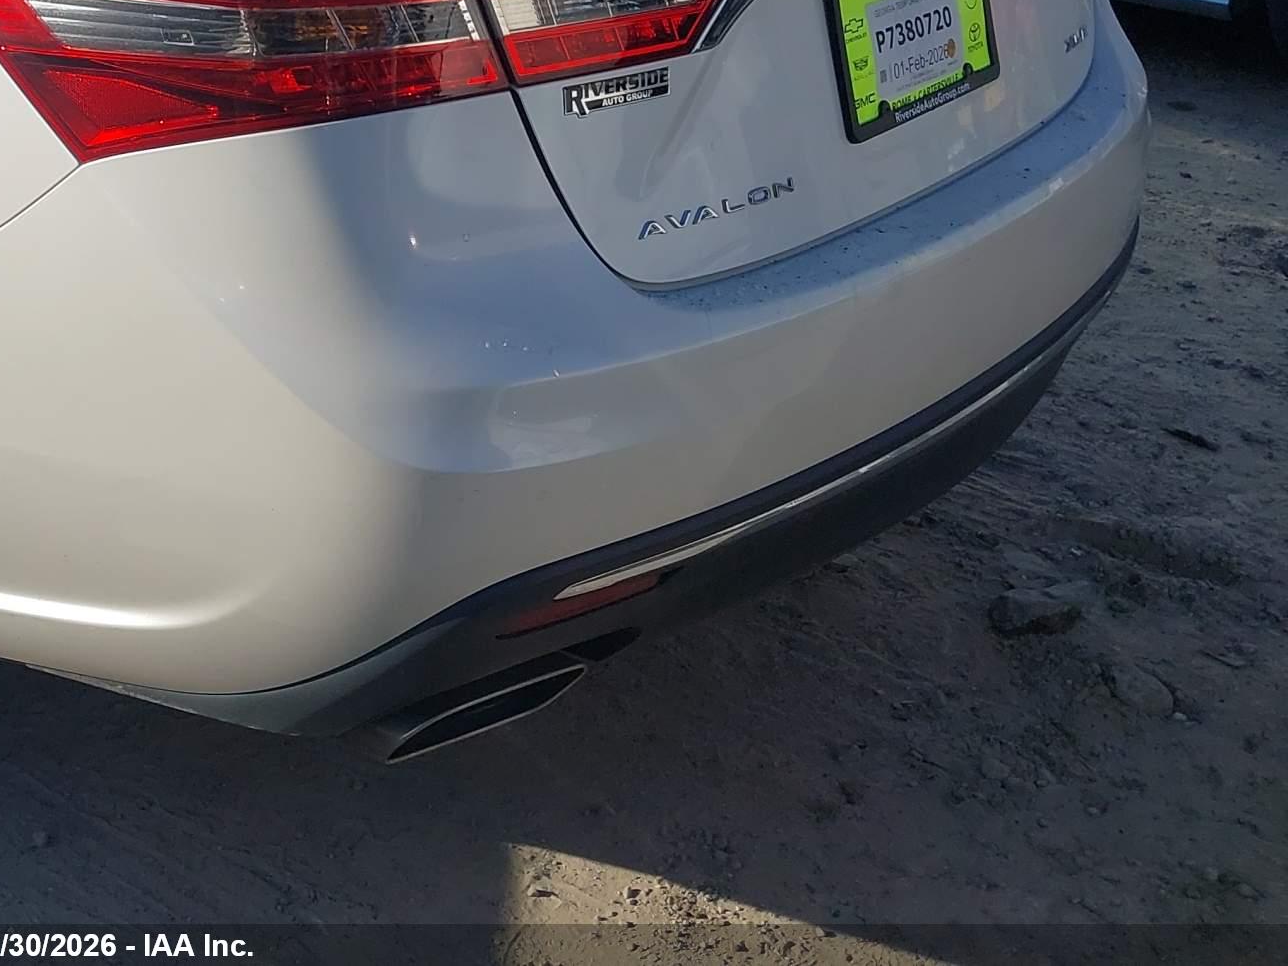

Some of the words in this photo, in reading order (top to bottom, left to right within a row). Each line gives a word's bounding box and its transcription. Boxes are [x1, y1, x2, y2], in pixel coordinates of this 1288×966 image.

[875, 6, 952, 53] P7380720
[563, 66, 669, 116] RIVERSIDE
[602, 94, 625, 107] AUTO
[626, 89, 654, 102] GROUP
[854, 91, 876, 109] GMC
[895, 82, 971, 123] RiversideAutoGroup.com
[638, 177, 795, 240] AVALON
